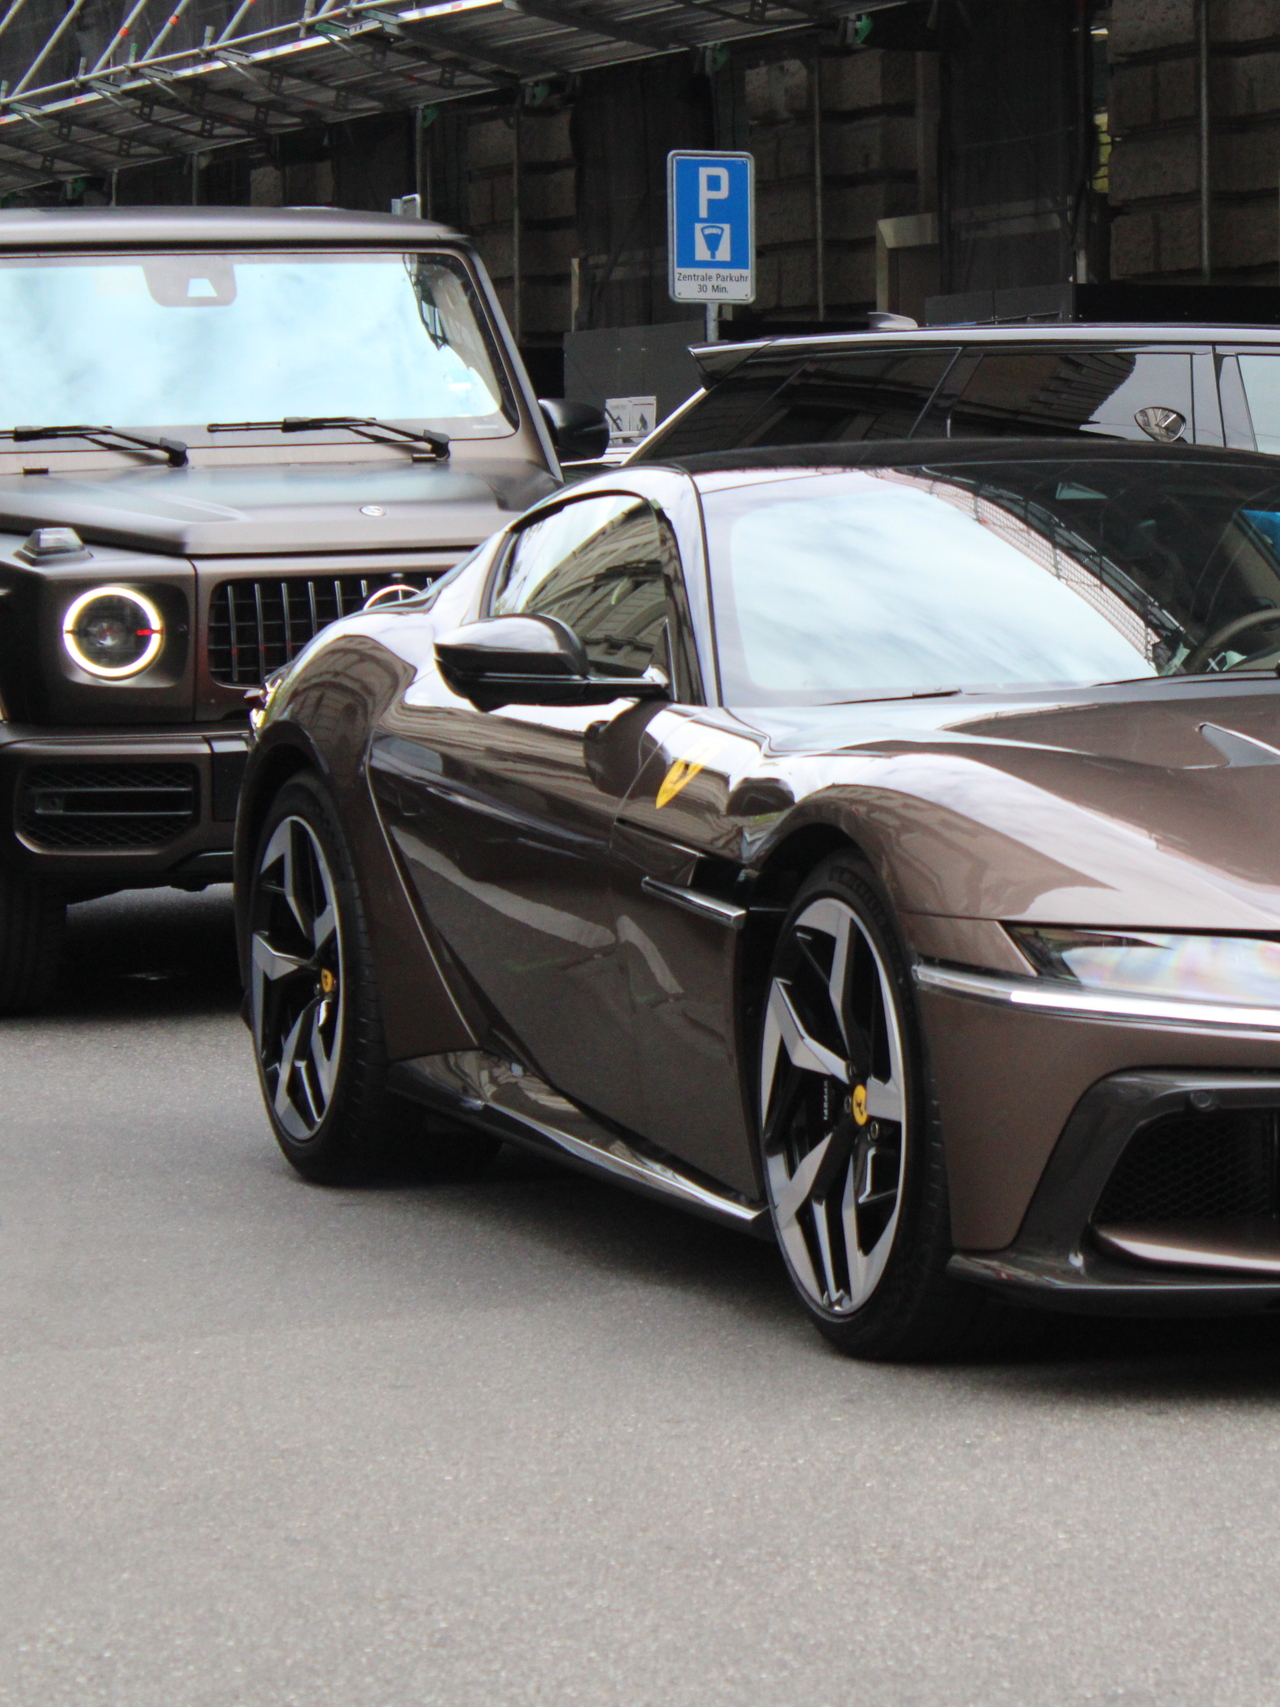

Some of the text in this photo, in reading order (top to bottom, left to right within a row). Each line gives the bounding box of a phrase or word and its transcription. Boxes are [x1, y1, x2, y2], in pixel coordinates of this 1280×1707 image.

[698, 166, 730, 219] P
[677, 272, 749, 283] Zentrale Parkuhr
[697, 284, 729, 293] 30 Min.
